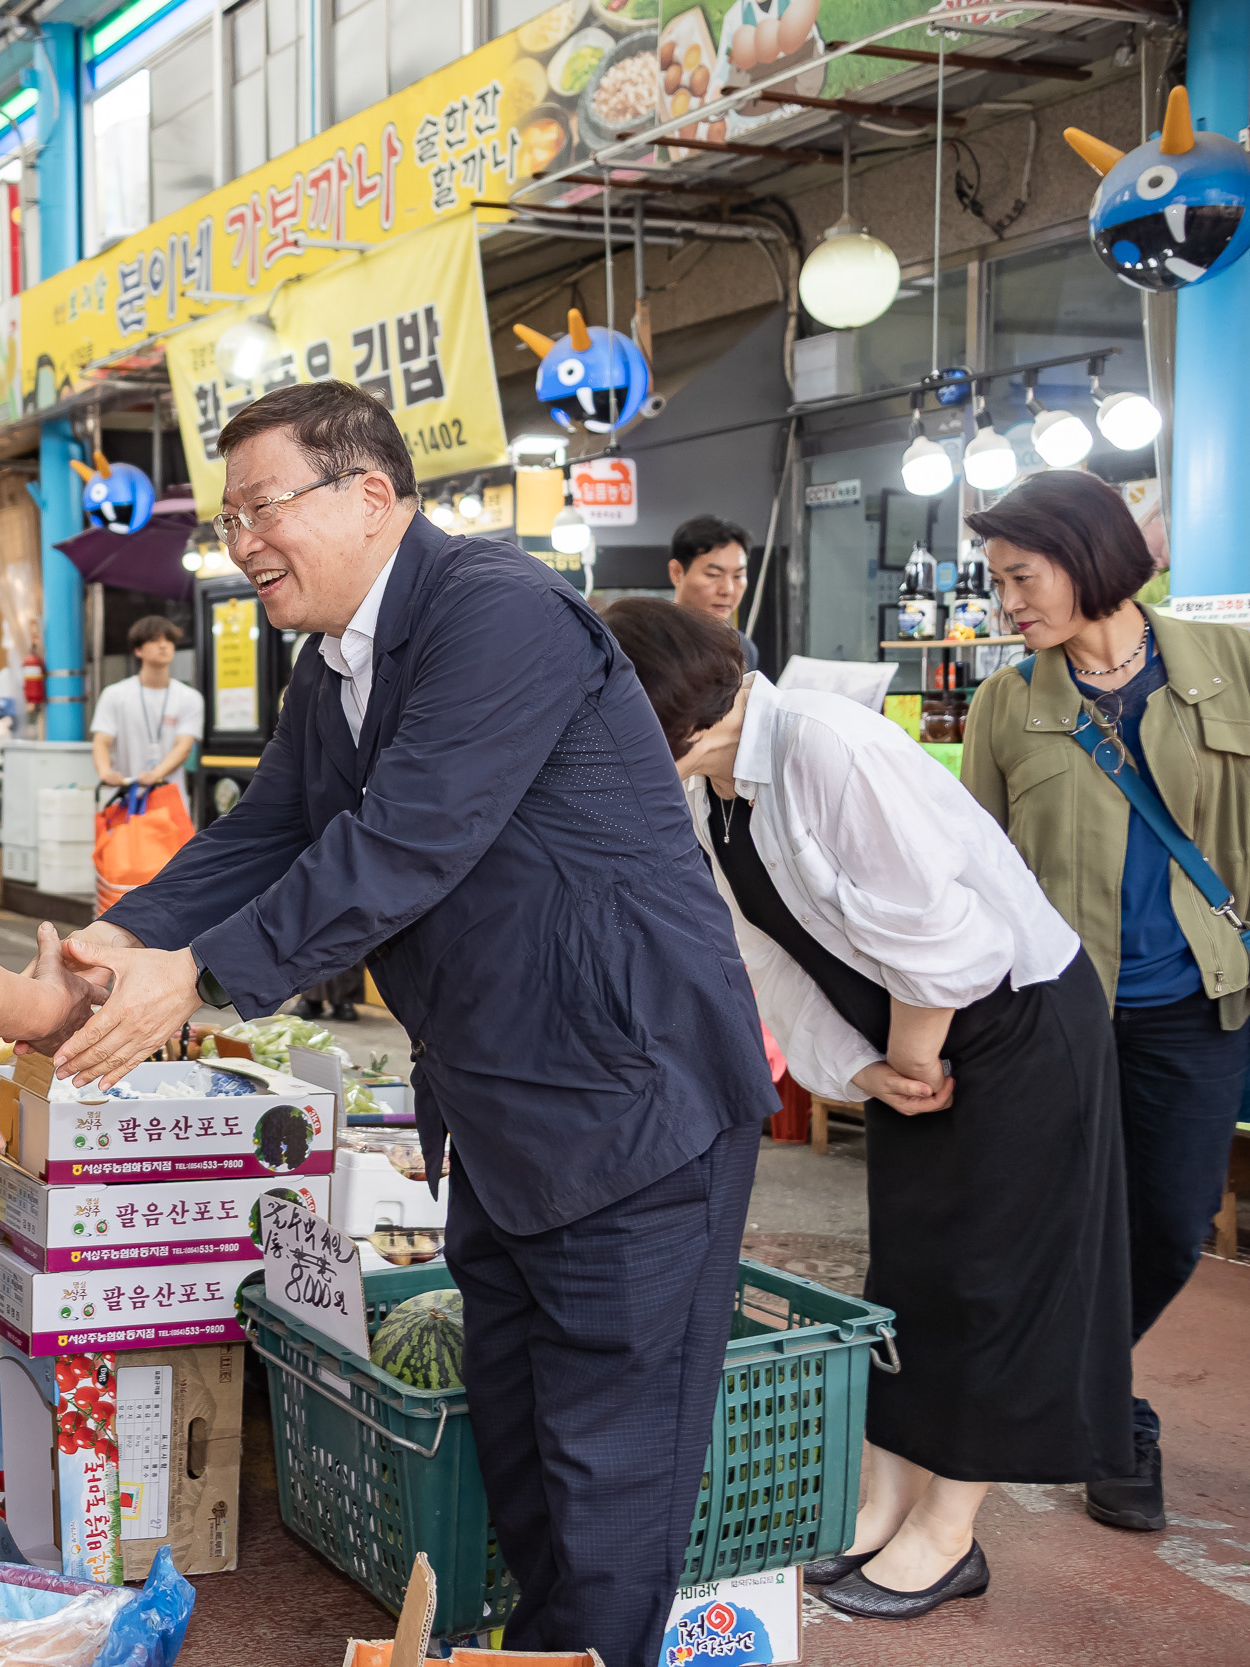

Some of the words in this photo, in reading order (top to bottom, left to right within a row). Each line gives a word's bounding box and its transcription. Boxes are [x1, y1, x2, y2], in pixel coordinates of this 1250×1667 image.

[415, 80, 503, 165] 술한잔
[430, 127, 521, 212] 할까나
[115, 212, 214, 338] 분이네
[225, 121, 404, 287] 가보까나
[117, 1115, 243, 1143] 팔음산포도
[115, 1199, 240, 1229] 팔음산포도
[102, 1281, 225, 1312] 팔음산포도
[674, 1582, 720, 1601] 샤인머
[696, 1631, 754, 1656] 과수원의
